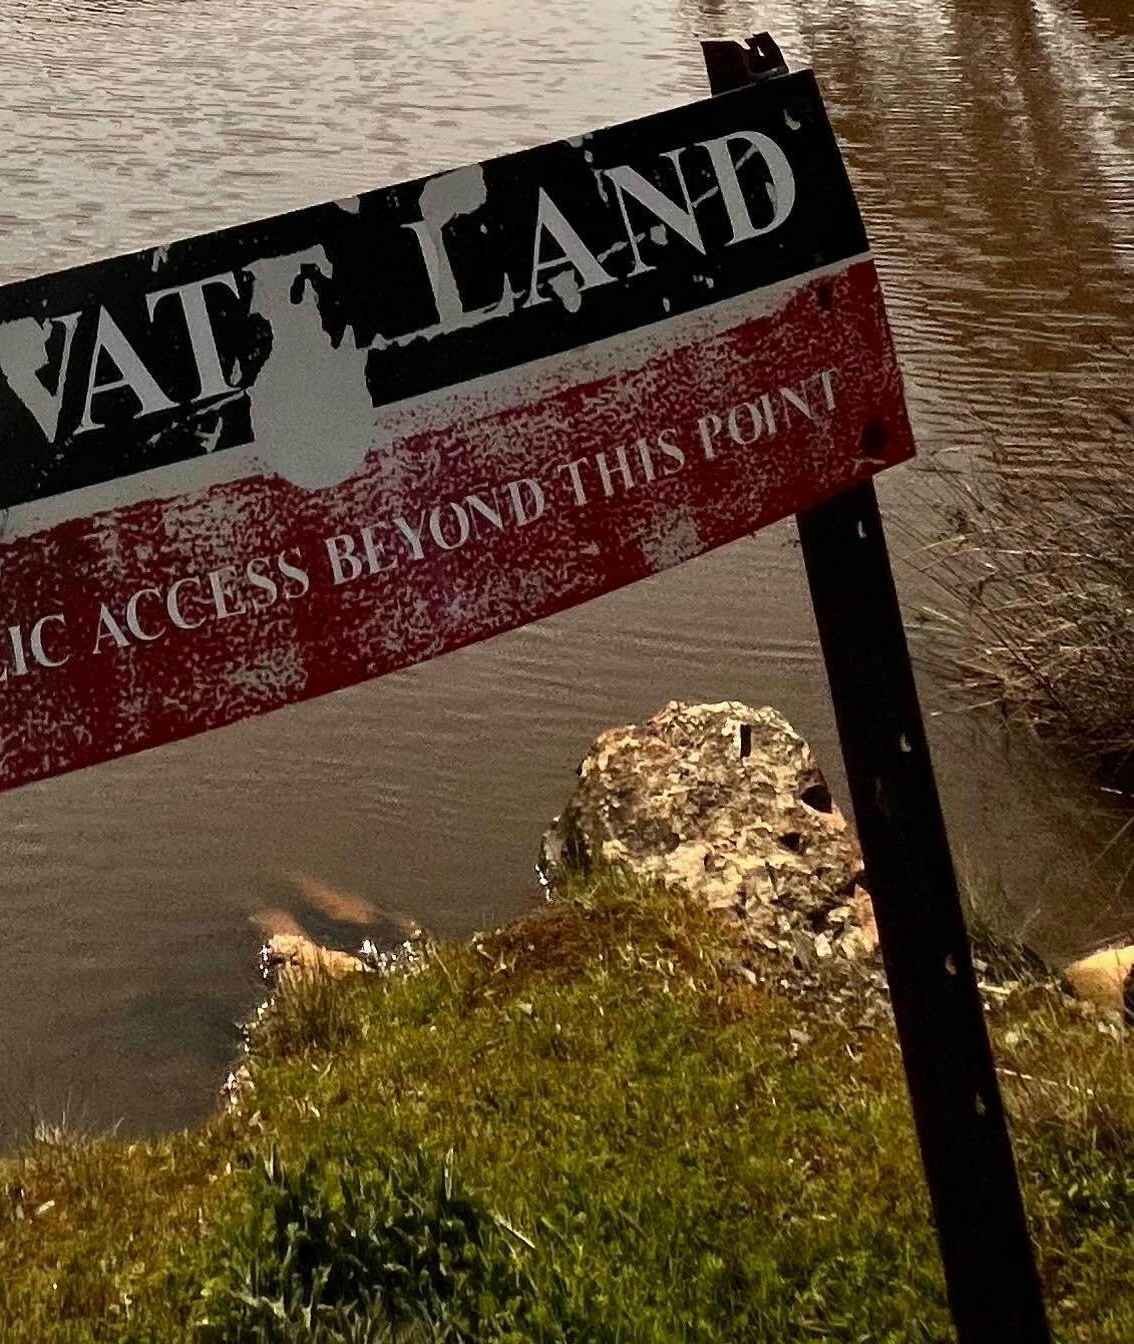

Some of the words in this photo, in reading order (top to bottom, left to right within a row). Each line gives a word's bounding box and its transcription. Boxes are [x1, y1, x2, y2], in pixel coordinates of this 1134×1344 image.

[400, 130, 796, 334] LAND
[92, 546, 311, 655] ACCESS
[324, 477, 545, 586] BEYOND
[558, 427, 686, 507] THIS
[696, 367, 839, 461] POINT
